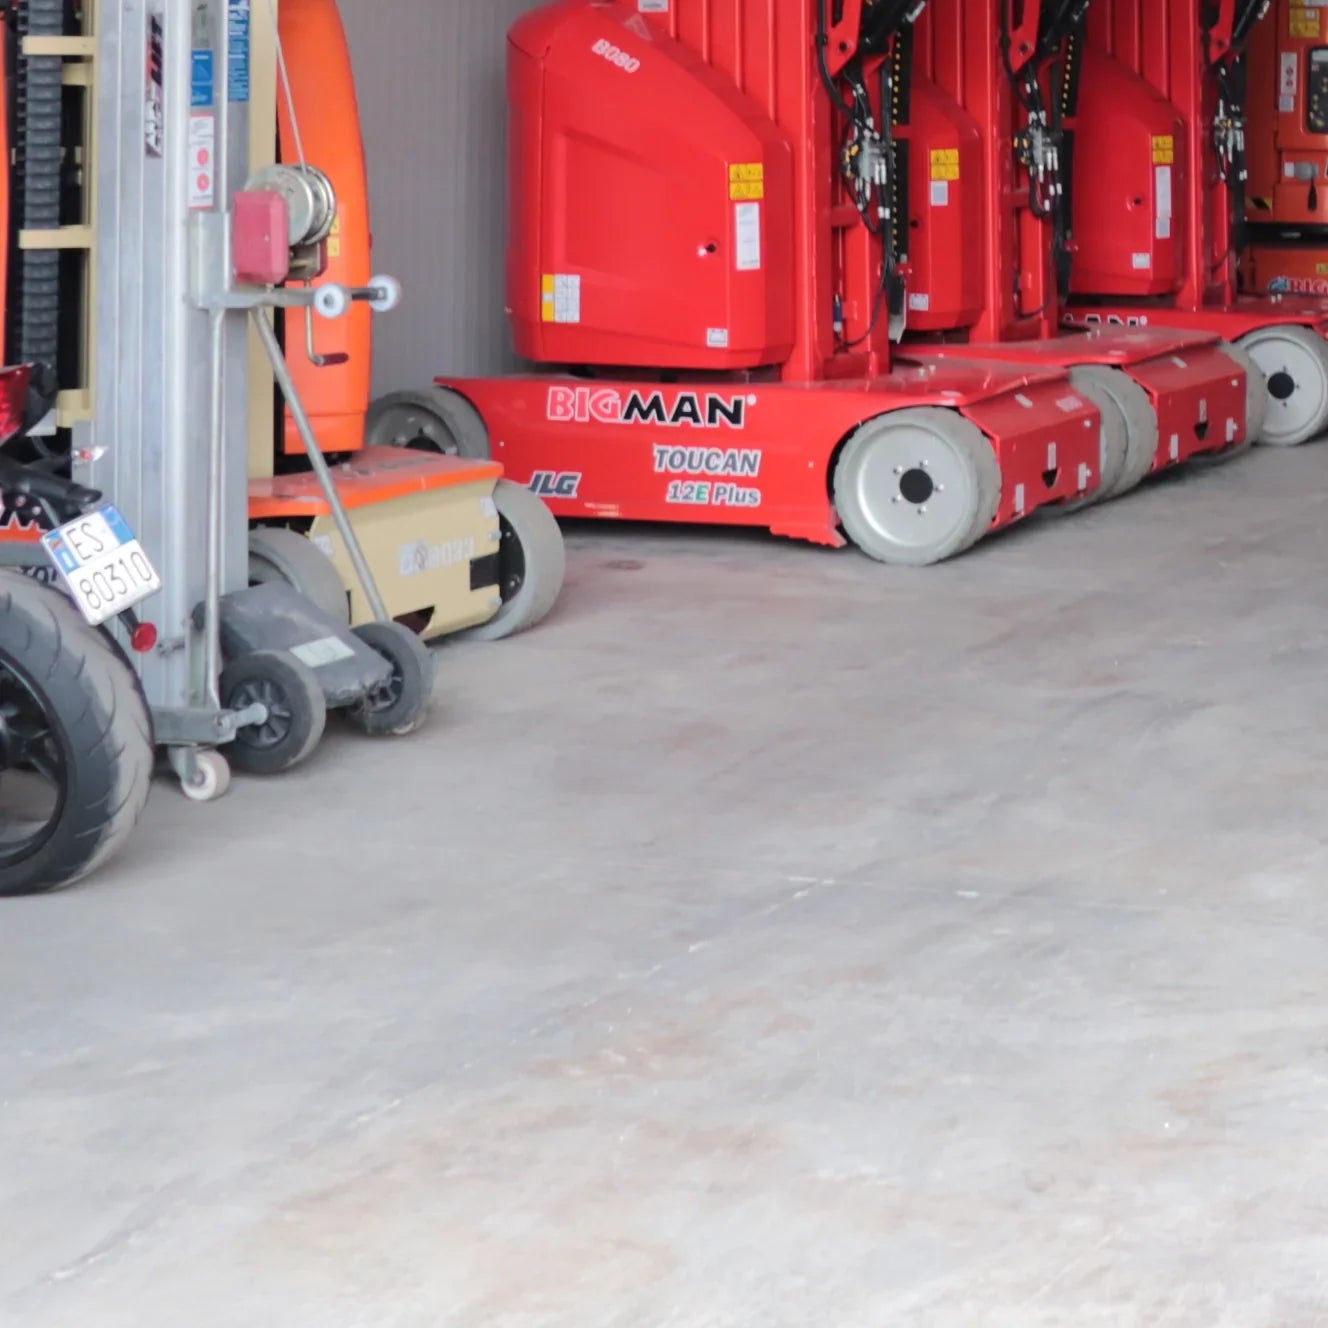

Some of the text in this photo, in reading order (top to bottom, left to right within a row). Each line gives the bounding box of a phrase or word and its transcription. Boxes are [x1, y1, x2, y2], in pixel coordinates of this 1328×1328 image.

[591, 38, 641, 73] B080
[547, 386, 747, 429] BIGMAN
[653, 443, 762, 476] TOUCAN
[526, 471, 582, 497] JLG
[666, 480, 761, 507] 12E Plus
[66, 522, 104, 561] ES
[79, 551, 153, 610] 80310
